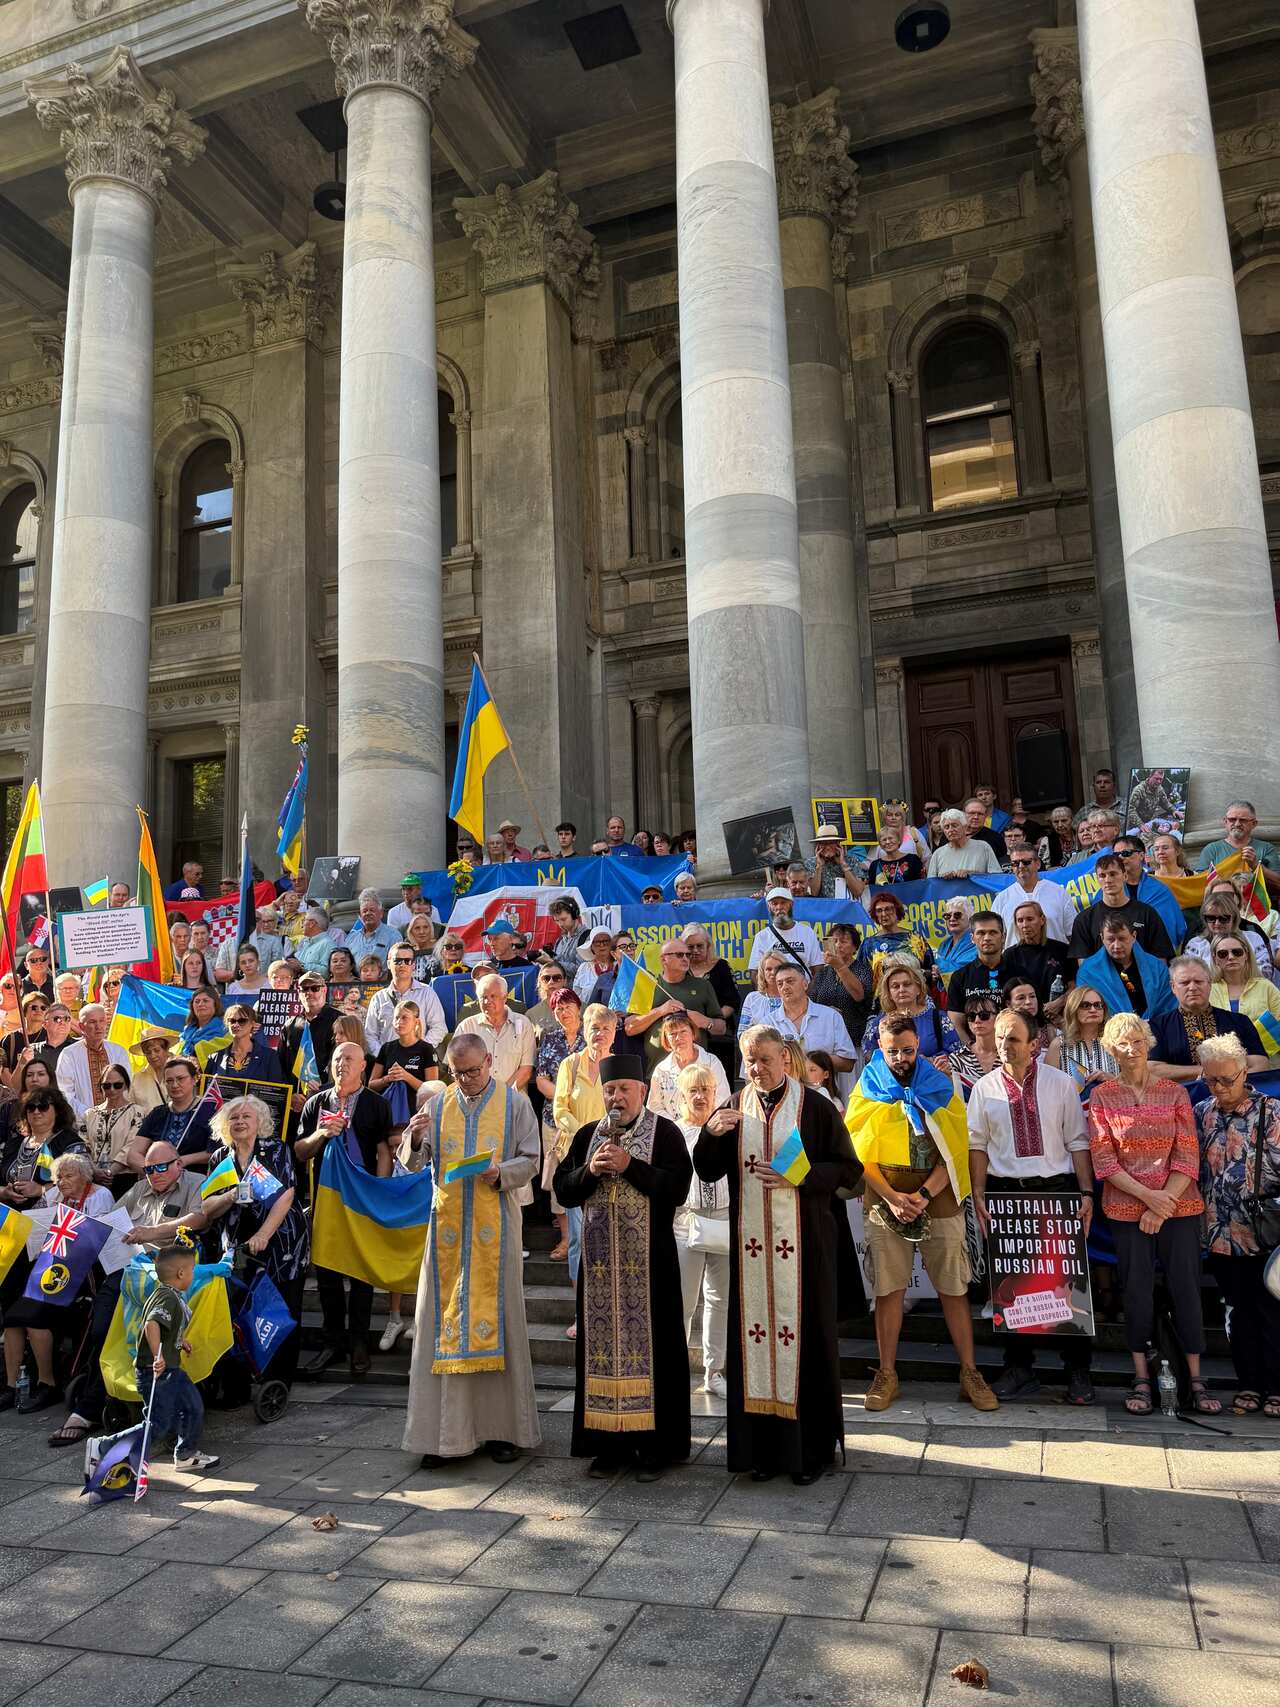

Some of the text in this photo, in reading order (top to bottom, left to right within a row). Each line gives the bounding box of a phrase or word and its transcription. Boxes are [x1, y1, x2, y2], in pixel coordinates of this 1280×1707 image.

[773, 941, 805, 950] NATICA
[260, 1003, 290, 1013] PLEASE
[988, 1199, 1063, 1215] AUSTRALIA
[990, 1219, 1082, 1235] PLEASE STOP
[999, 1239, 1076, 1255] IMPORTING
[994, 1258, 1085, 1275] RUSSIAN OIL
[1033, 1303, 1054, 1313] RUSSIA
[1055, 1300, 1066, 1309] VIA
[1008, 1316, 1036, 1326] SANCTION
[1038, 1310, 1069, 1322] LOOPHOLES
